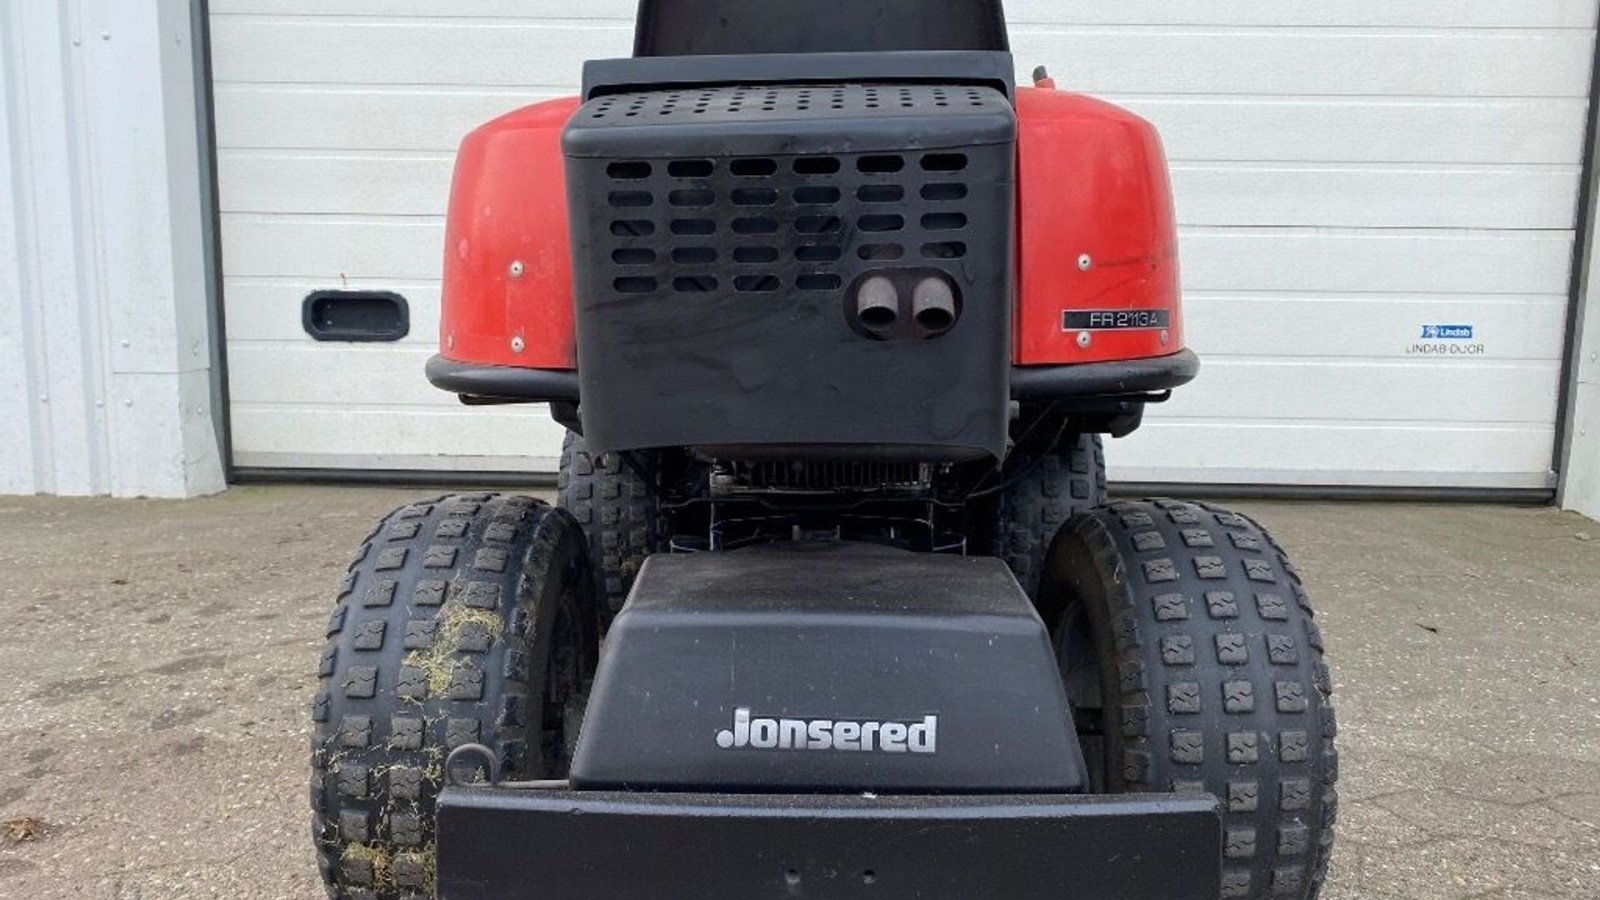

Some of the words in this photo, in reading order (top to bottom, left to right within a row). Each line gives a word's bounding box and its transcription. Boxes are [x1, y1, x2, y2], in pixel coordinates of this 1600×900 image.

[1090, 312, 1114, 326] FR
[1440, 327, 1470, 337] Lindab
[715, 708, 937, 753] Jonsered
